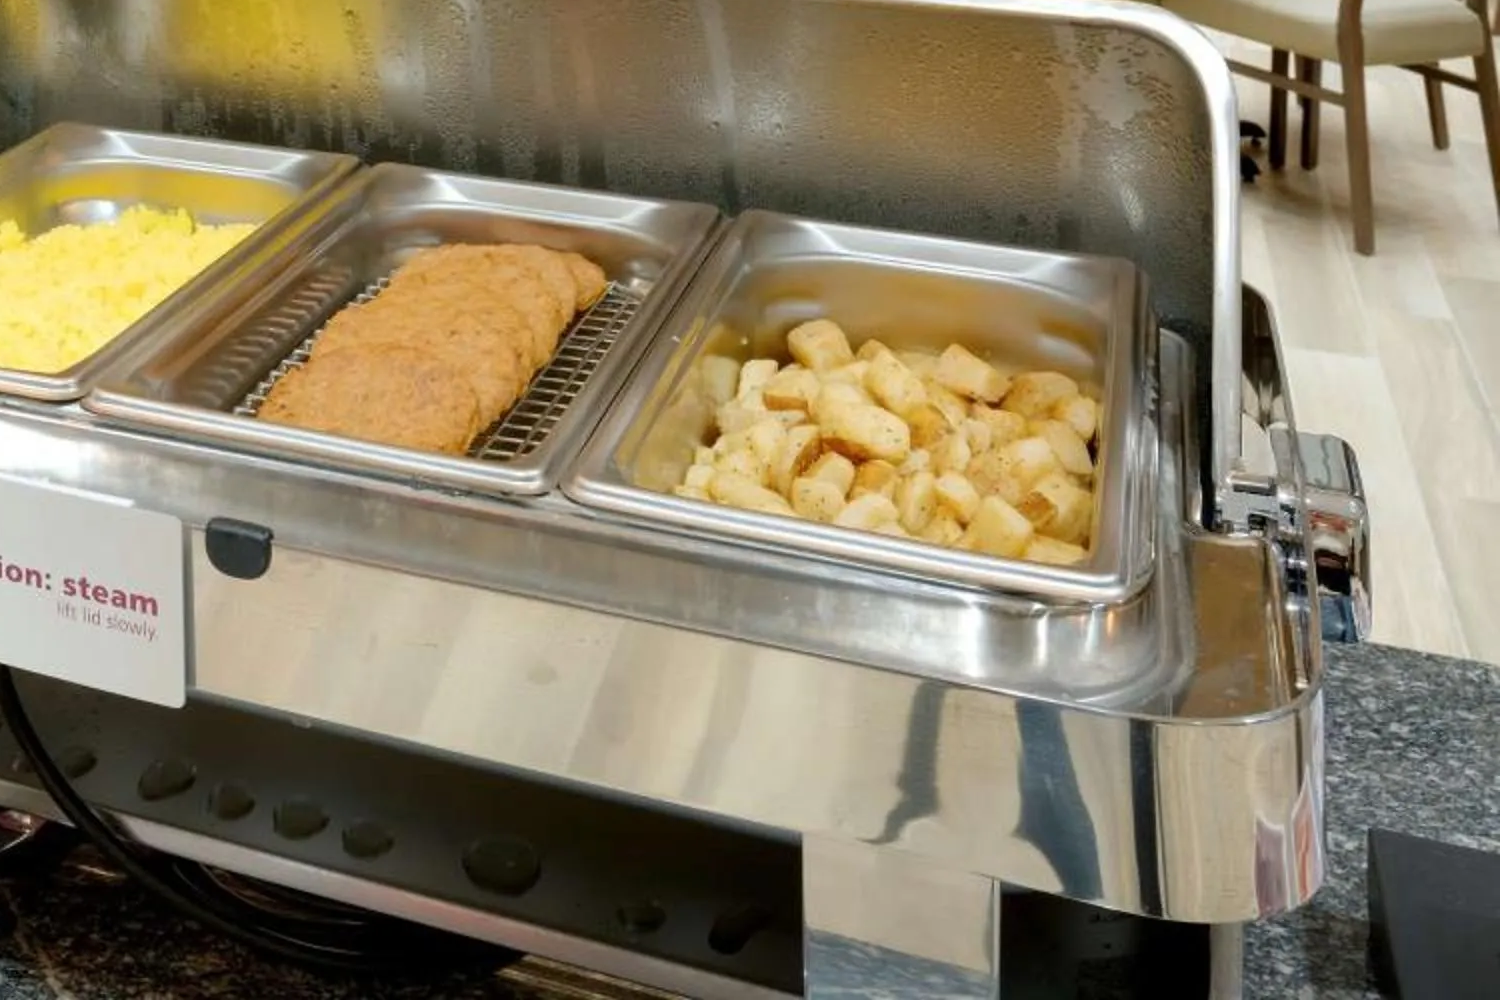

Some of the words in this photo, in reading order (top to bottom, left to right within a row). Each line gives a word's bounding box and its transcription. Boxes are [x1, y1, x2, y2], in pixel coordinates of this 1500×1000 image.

[62, 575, 159, 617] steam
[56, 601, 77, 619] lift
[82, 609, 102, 627] lid
[106, 616, 160, 643] slowly.
